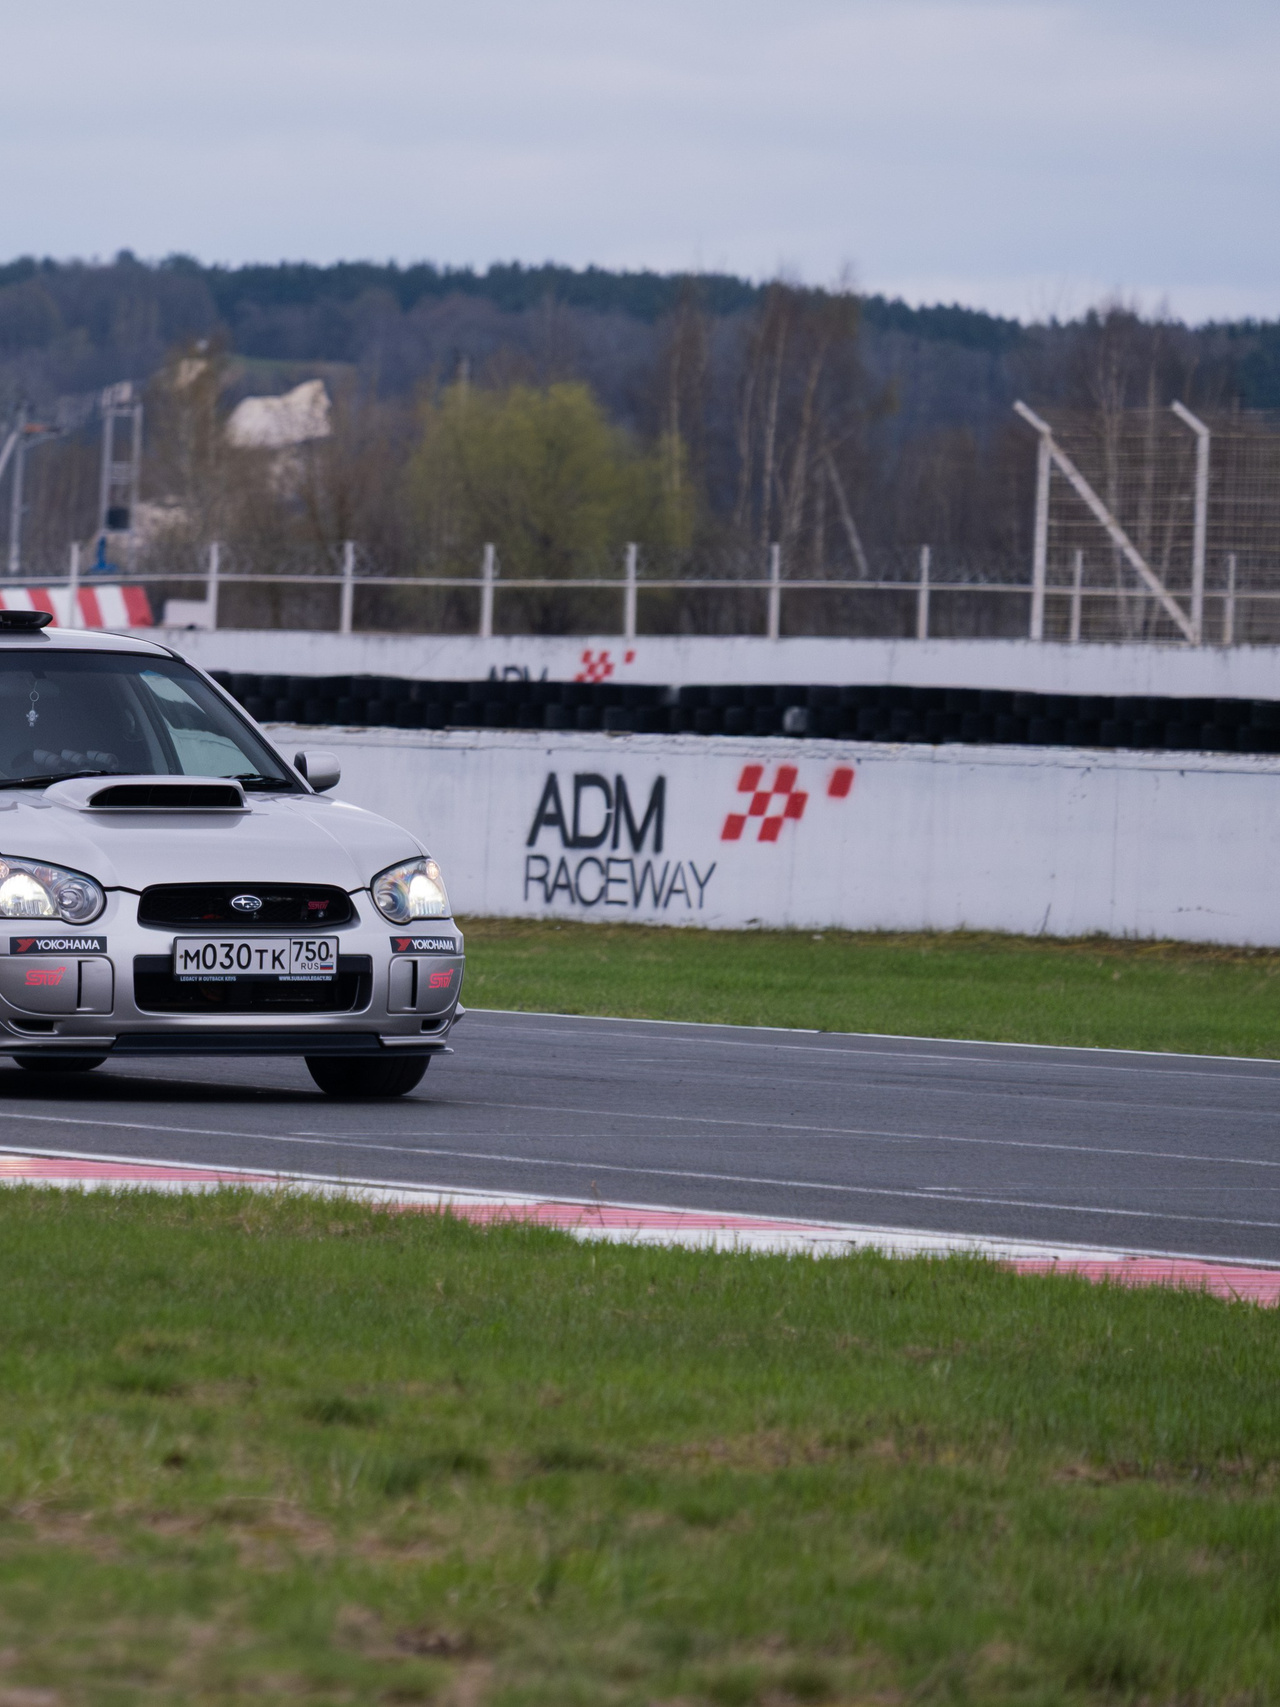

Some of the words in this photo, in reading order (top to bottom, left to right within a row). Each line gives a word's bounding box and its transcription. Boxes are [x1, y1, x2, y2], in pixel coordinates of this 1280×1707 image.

[526, 771, 667, 854] ADM
[523, 854, 717, 910] RACEWAY
[35, 939, 101, 950] YOKOHAMA
[292, 941, 330, 962] 750
[411, 939, 455, 951] YOKOHAMA
[300, 962, 320, 970] RUS
